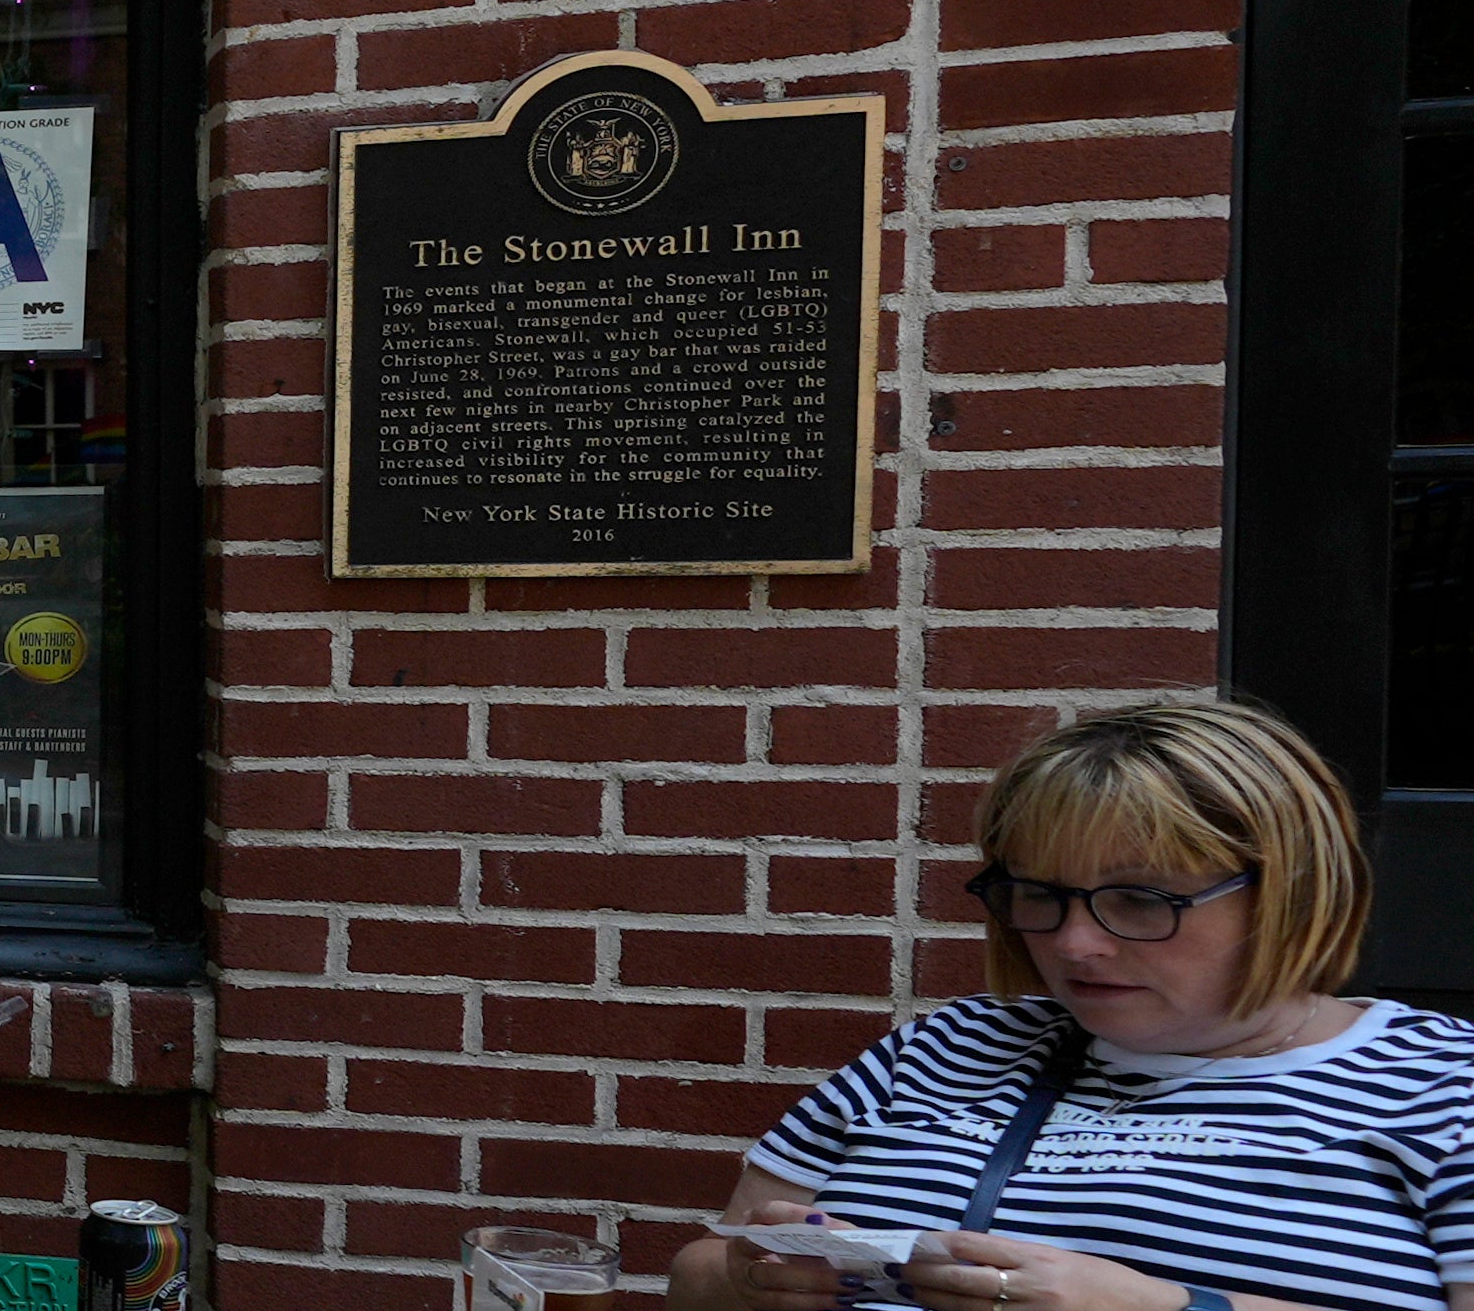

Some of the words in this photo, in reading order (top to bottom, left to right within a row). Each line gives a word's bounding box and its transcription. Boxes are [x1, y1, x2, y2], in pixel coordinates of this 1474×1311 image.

[29, 118, 70, 128] GRADE
[548, 102, 587, 131] STATE
[594, 97, 615, 108] OF
[619, 99, 653, 117] NEW
[652, 117, 672, 153] YORK
[409, 237, 483, 269] The
[503, 226, 711, 265] Stonewall
[732, 224, 804, 253] Inn
[383, 286, 414, 299] The
[425, 285, 480, 297] events
[491, 281, 524, 294] that
[535, 280, 586, 294] began
[598, 278, 614, 289] at
[627, 276, 654, 288] the
[665, 270, 755, 287] Stonewall
[769, 269, 798, 282] Inn
[811, 267, 829, 280] in
[23, 302, 64, 315] NYC
[384, 302, 423, 316] 1969
[433, 300, 496, 314] marked
[525, 294, 633, 310] monumental
[644, 291, 707, 306] change
[719, 289, 745, 302] for
[517, 312, 619, 328] transgender
[632, 310, 663, 323] and
[676, 310, 727, 324] queer
[739, 303, 827, 321] (LGBTQ)
[605, 328, 659, 341] which
[673, 324, 759, 339] occupied
[772, 320, 827, 335] 51-53
[422, 504, 472, 526] New
[484, 504, 537, 525] York
[547, 502, 607, 523] State
[617, 499, 715, 522] Historic
[726, 499, 774, 519] Site
[572, 528, 615, 544] 2016
[19, 632, 75, 647] MON-THURS
[22, 649, 71, 665] 9:00PM
[15, 728, 45, 738] GUESTS
[48, 728, 86, 739] PIANISTS
[0, 741, 22, 751] STAFF
[35, 741, 86, 752] BARTENDERS
